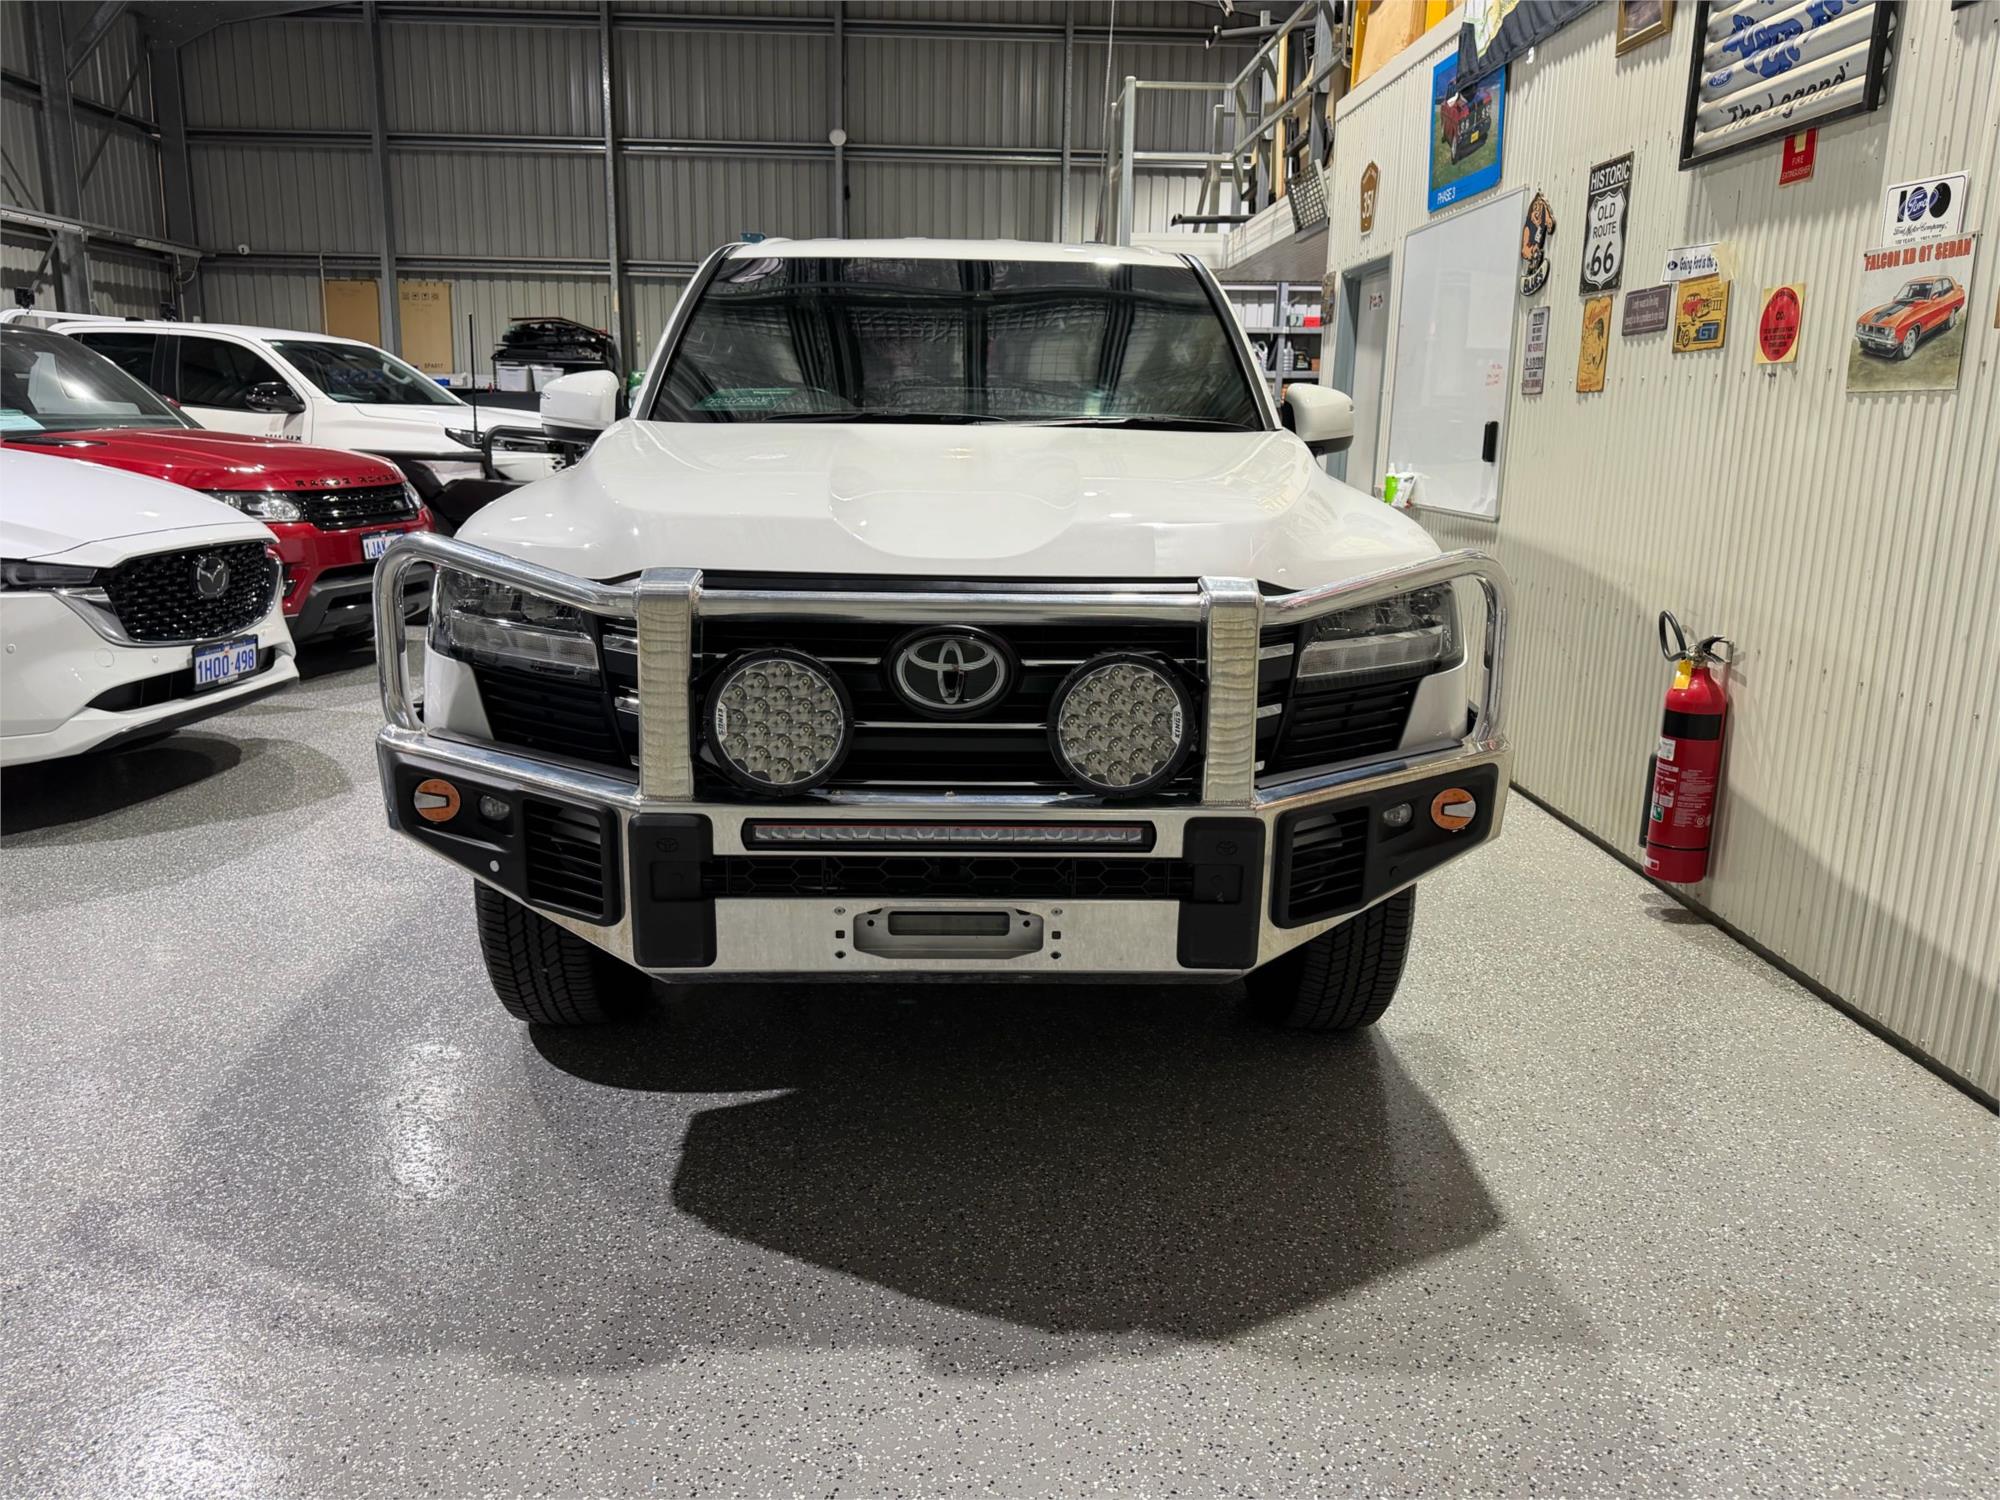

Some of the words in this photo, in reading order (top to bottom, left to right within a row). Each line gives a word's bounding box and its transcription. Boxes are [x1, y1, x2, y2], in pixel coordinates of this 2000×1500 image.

[1590, 161, 1630, 190] HISTORIC
[1362, 190, 1374, 218] 351
[1597, 202, 1616, 221] OLD
[1593, 221, 1617, 239] ROUTE
[1591, 241, 1614, 277] 66
[1865, 250, 1901, 271] FALCON
[1935, 238, 1972, 260] SEDAN
